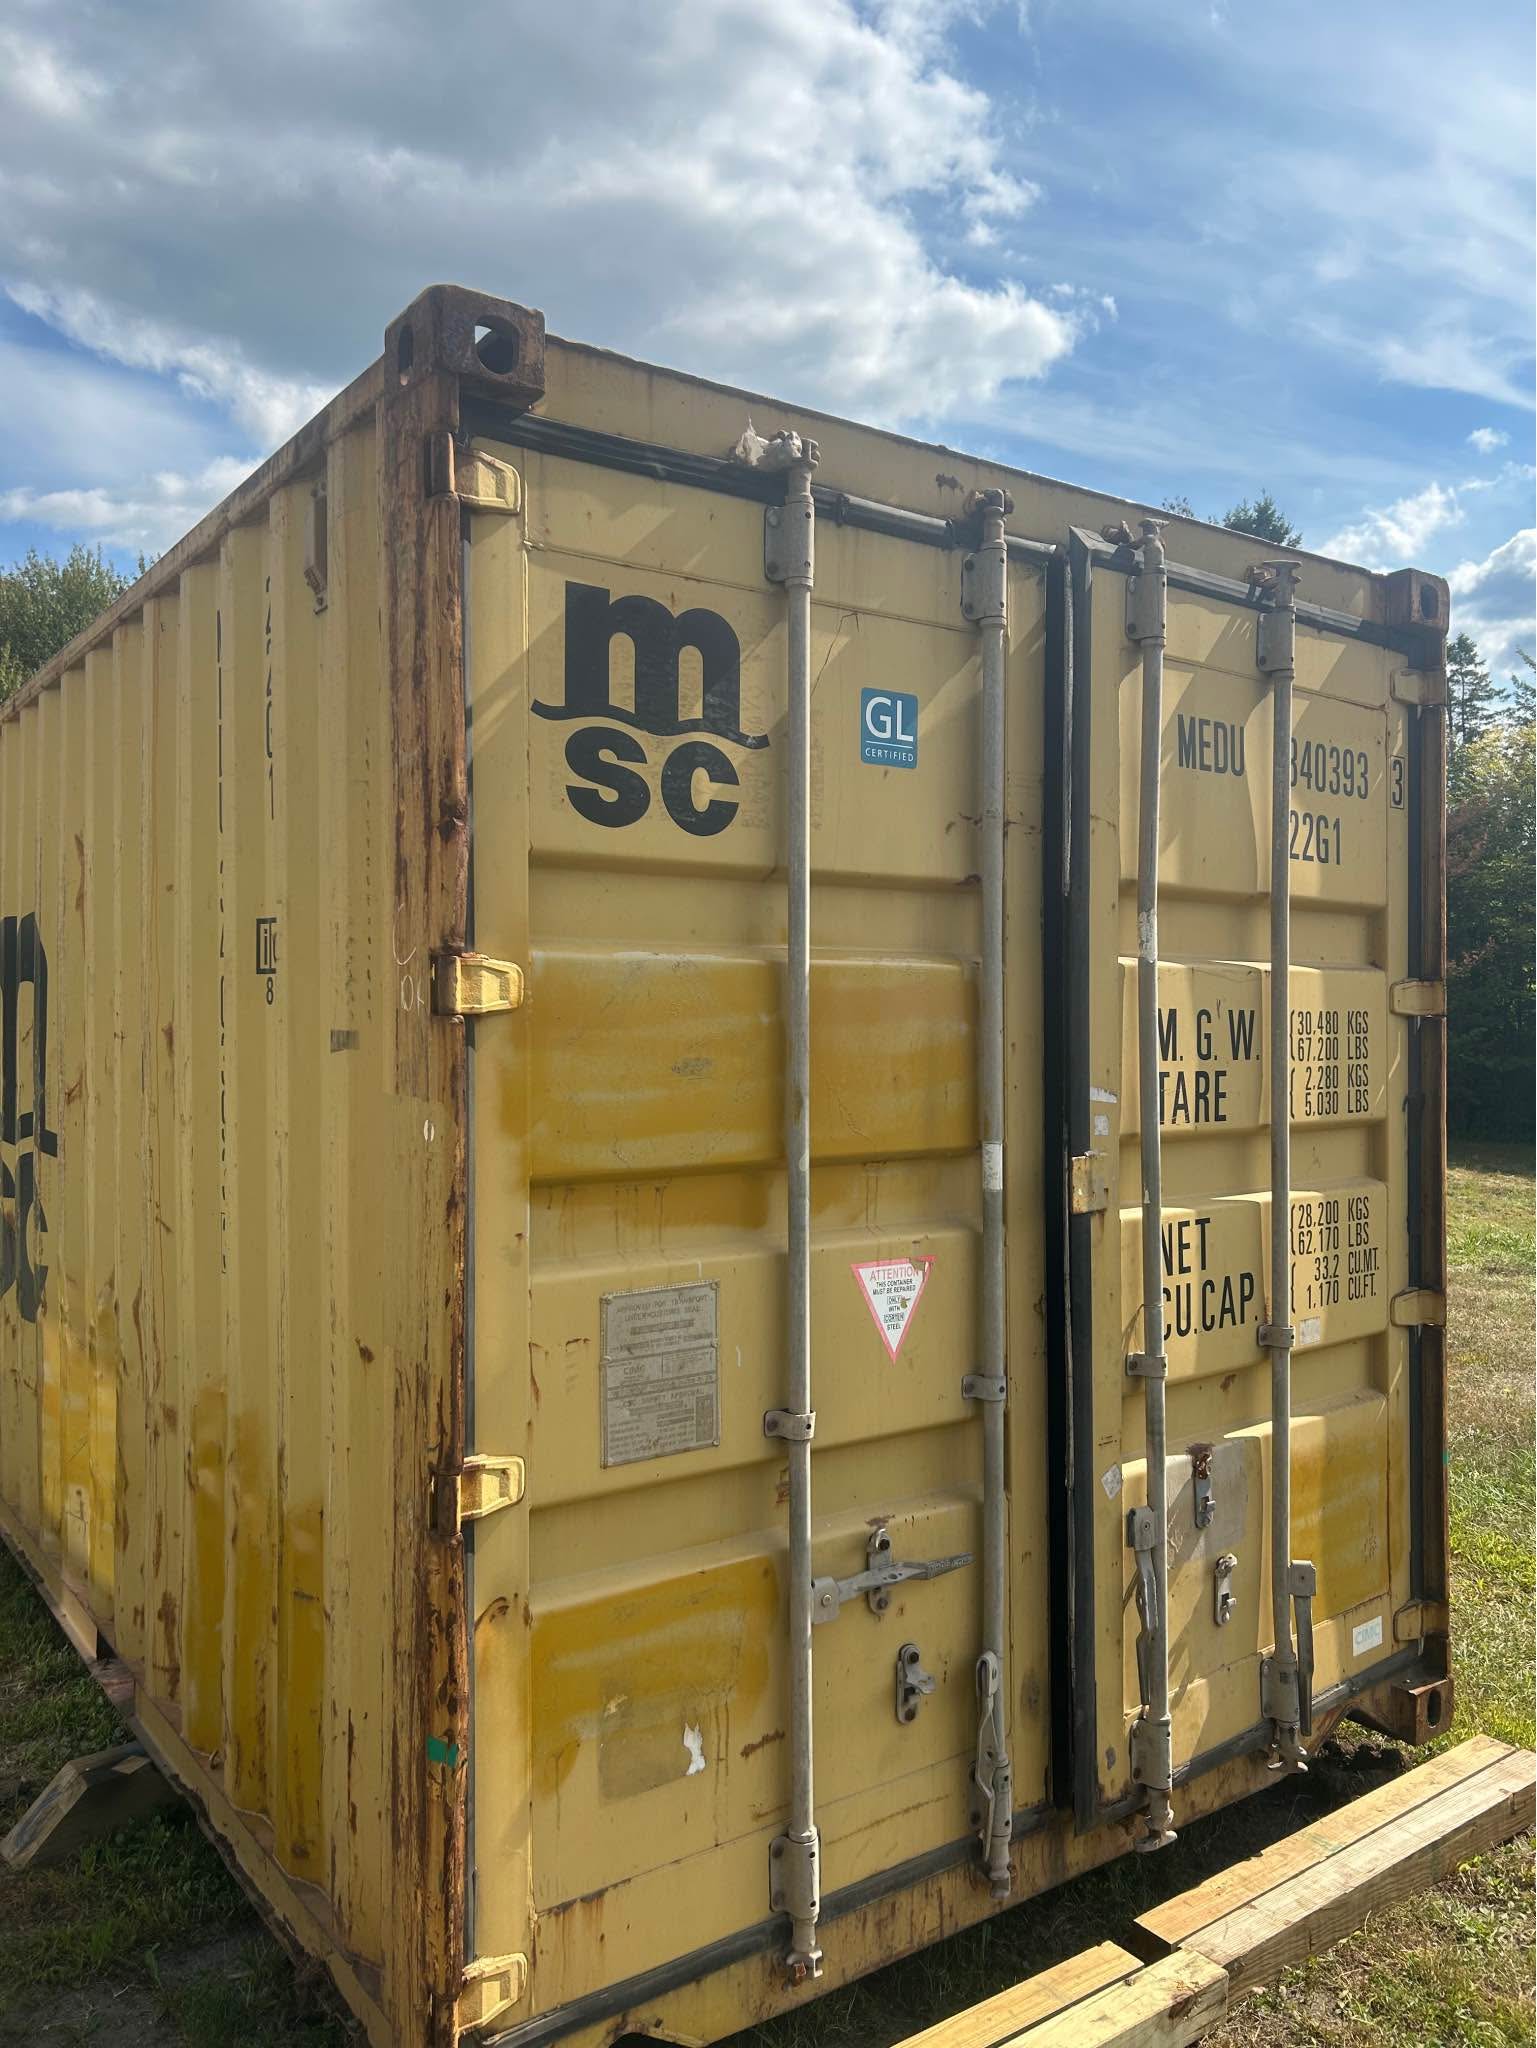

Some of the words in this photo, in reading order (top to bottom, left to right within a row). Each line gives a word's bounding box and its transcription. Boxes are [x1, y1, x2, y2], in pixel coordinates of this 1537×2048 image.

[865, 696, 914, 742] GL
[865, 747, 914, 762] CERTIFIED
[1177, 713, 1245, 776] MEDU
[1391, 759, 1404, 806] 3
[1289, 809, 1342, 866] 22G1
[1297, 1010, 1339, 1036] 30,480
[1347, 1010, 1369, 1035] KGS
[1297, 1036, 1339, 1062] 67,200
[1347, 1036, 1369, 1060] LBS
[1305, 1064, 1339, 1091] 2,280
[1347, 1063, 1369, 1088] KGS
[1158, 1070, 1227, 1125] TARE
[1305, 1090, 1339, 1117] 5,030
[1347, 1088, 1369, 1113] LBS
[1298, 1200, 1340, 1229] 28,200
[1347, 1196, 1369, 1222] KGS
[1161, 1217, 1211, 1277] NET
[1298, 1226, 1340, 1255] 62,170
[1347, 1221, 1369, 1248] LBS
[870, 1265, 919, 1281] ATTENTION
[1314, 1254, 1340, 1282] 33.2
[1306, 1279, 1340, 1310] 1,170
